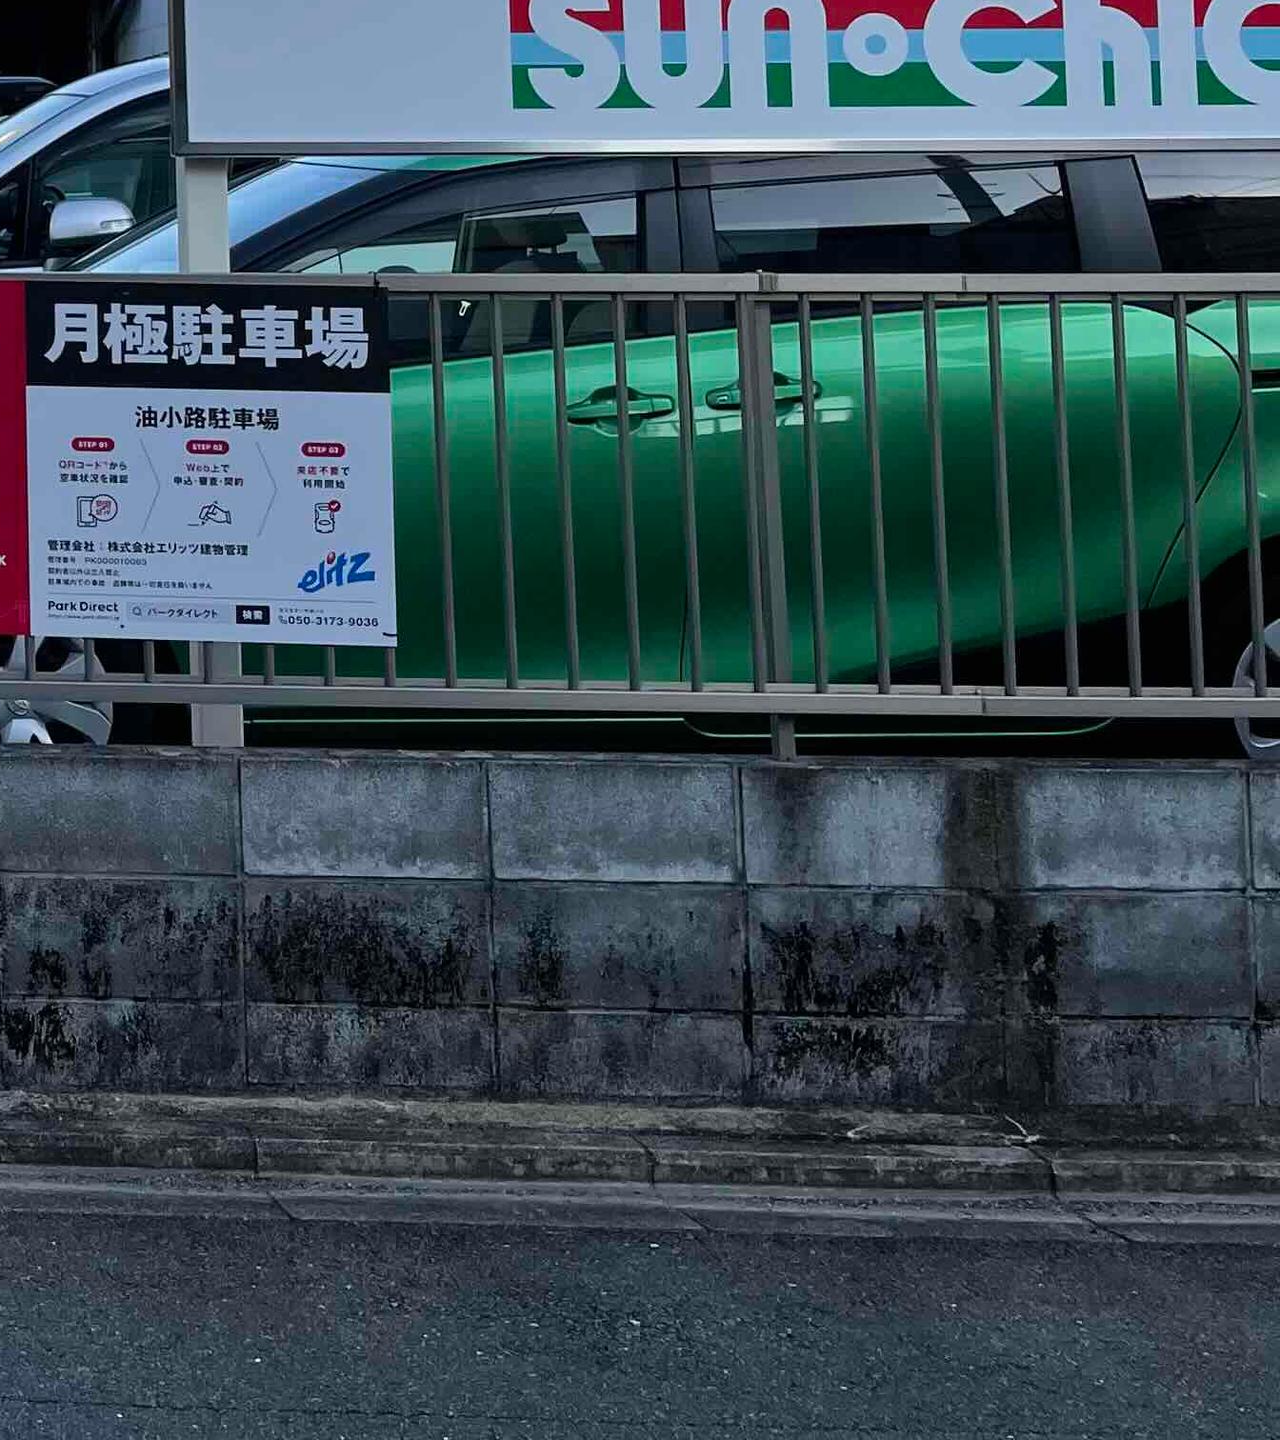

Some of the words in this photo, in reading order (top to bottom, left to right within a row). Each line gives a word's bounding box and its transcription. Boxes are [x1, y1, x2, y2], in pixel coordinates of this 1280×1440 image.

[44, 302, 370, 370] 月極駐車場
[134, 405, 280, 431] 油小路駐車場
[47, 600, 76, 612] Park
[79, 601, 119, 613] Direct
[287, 615, 380, 628] 050-3173-9036
